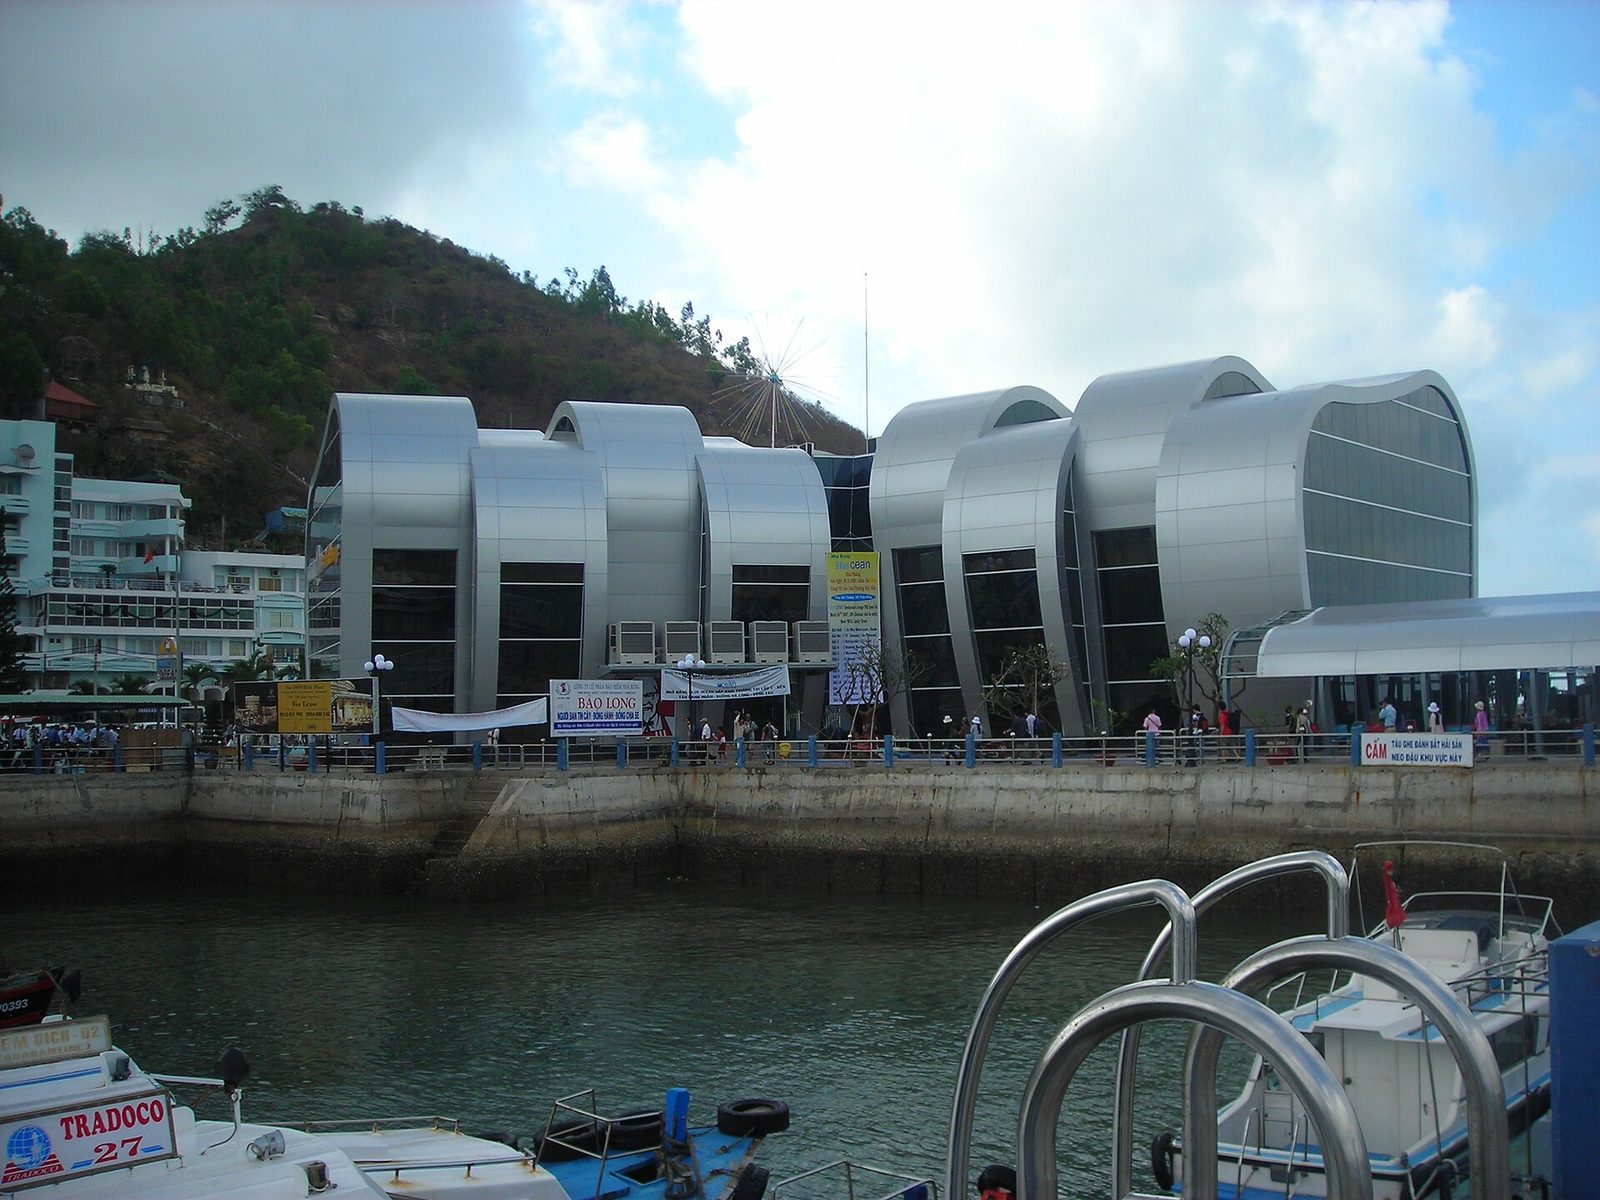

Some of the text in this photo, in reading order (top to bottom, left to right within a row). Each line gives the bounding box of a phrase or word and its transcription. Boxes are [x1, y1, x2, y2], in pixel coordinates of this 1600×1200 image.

[606, 697, 636, 709] LONG
[1365, 738, 1387, 759] CẤM
[1391, 753, 1404, 762] NEO
[1420, 753, 1434, 762] KHU
[0, 999, 28, 1013] 0393
[60, 1099, 165, 1141] TRADOCO
[94, 1136, 144, 1165] 27
[6, 1165, 61, 1182] TRADOCO
